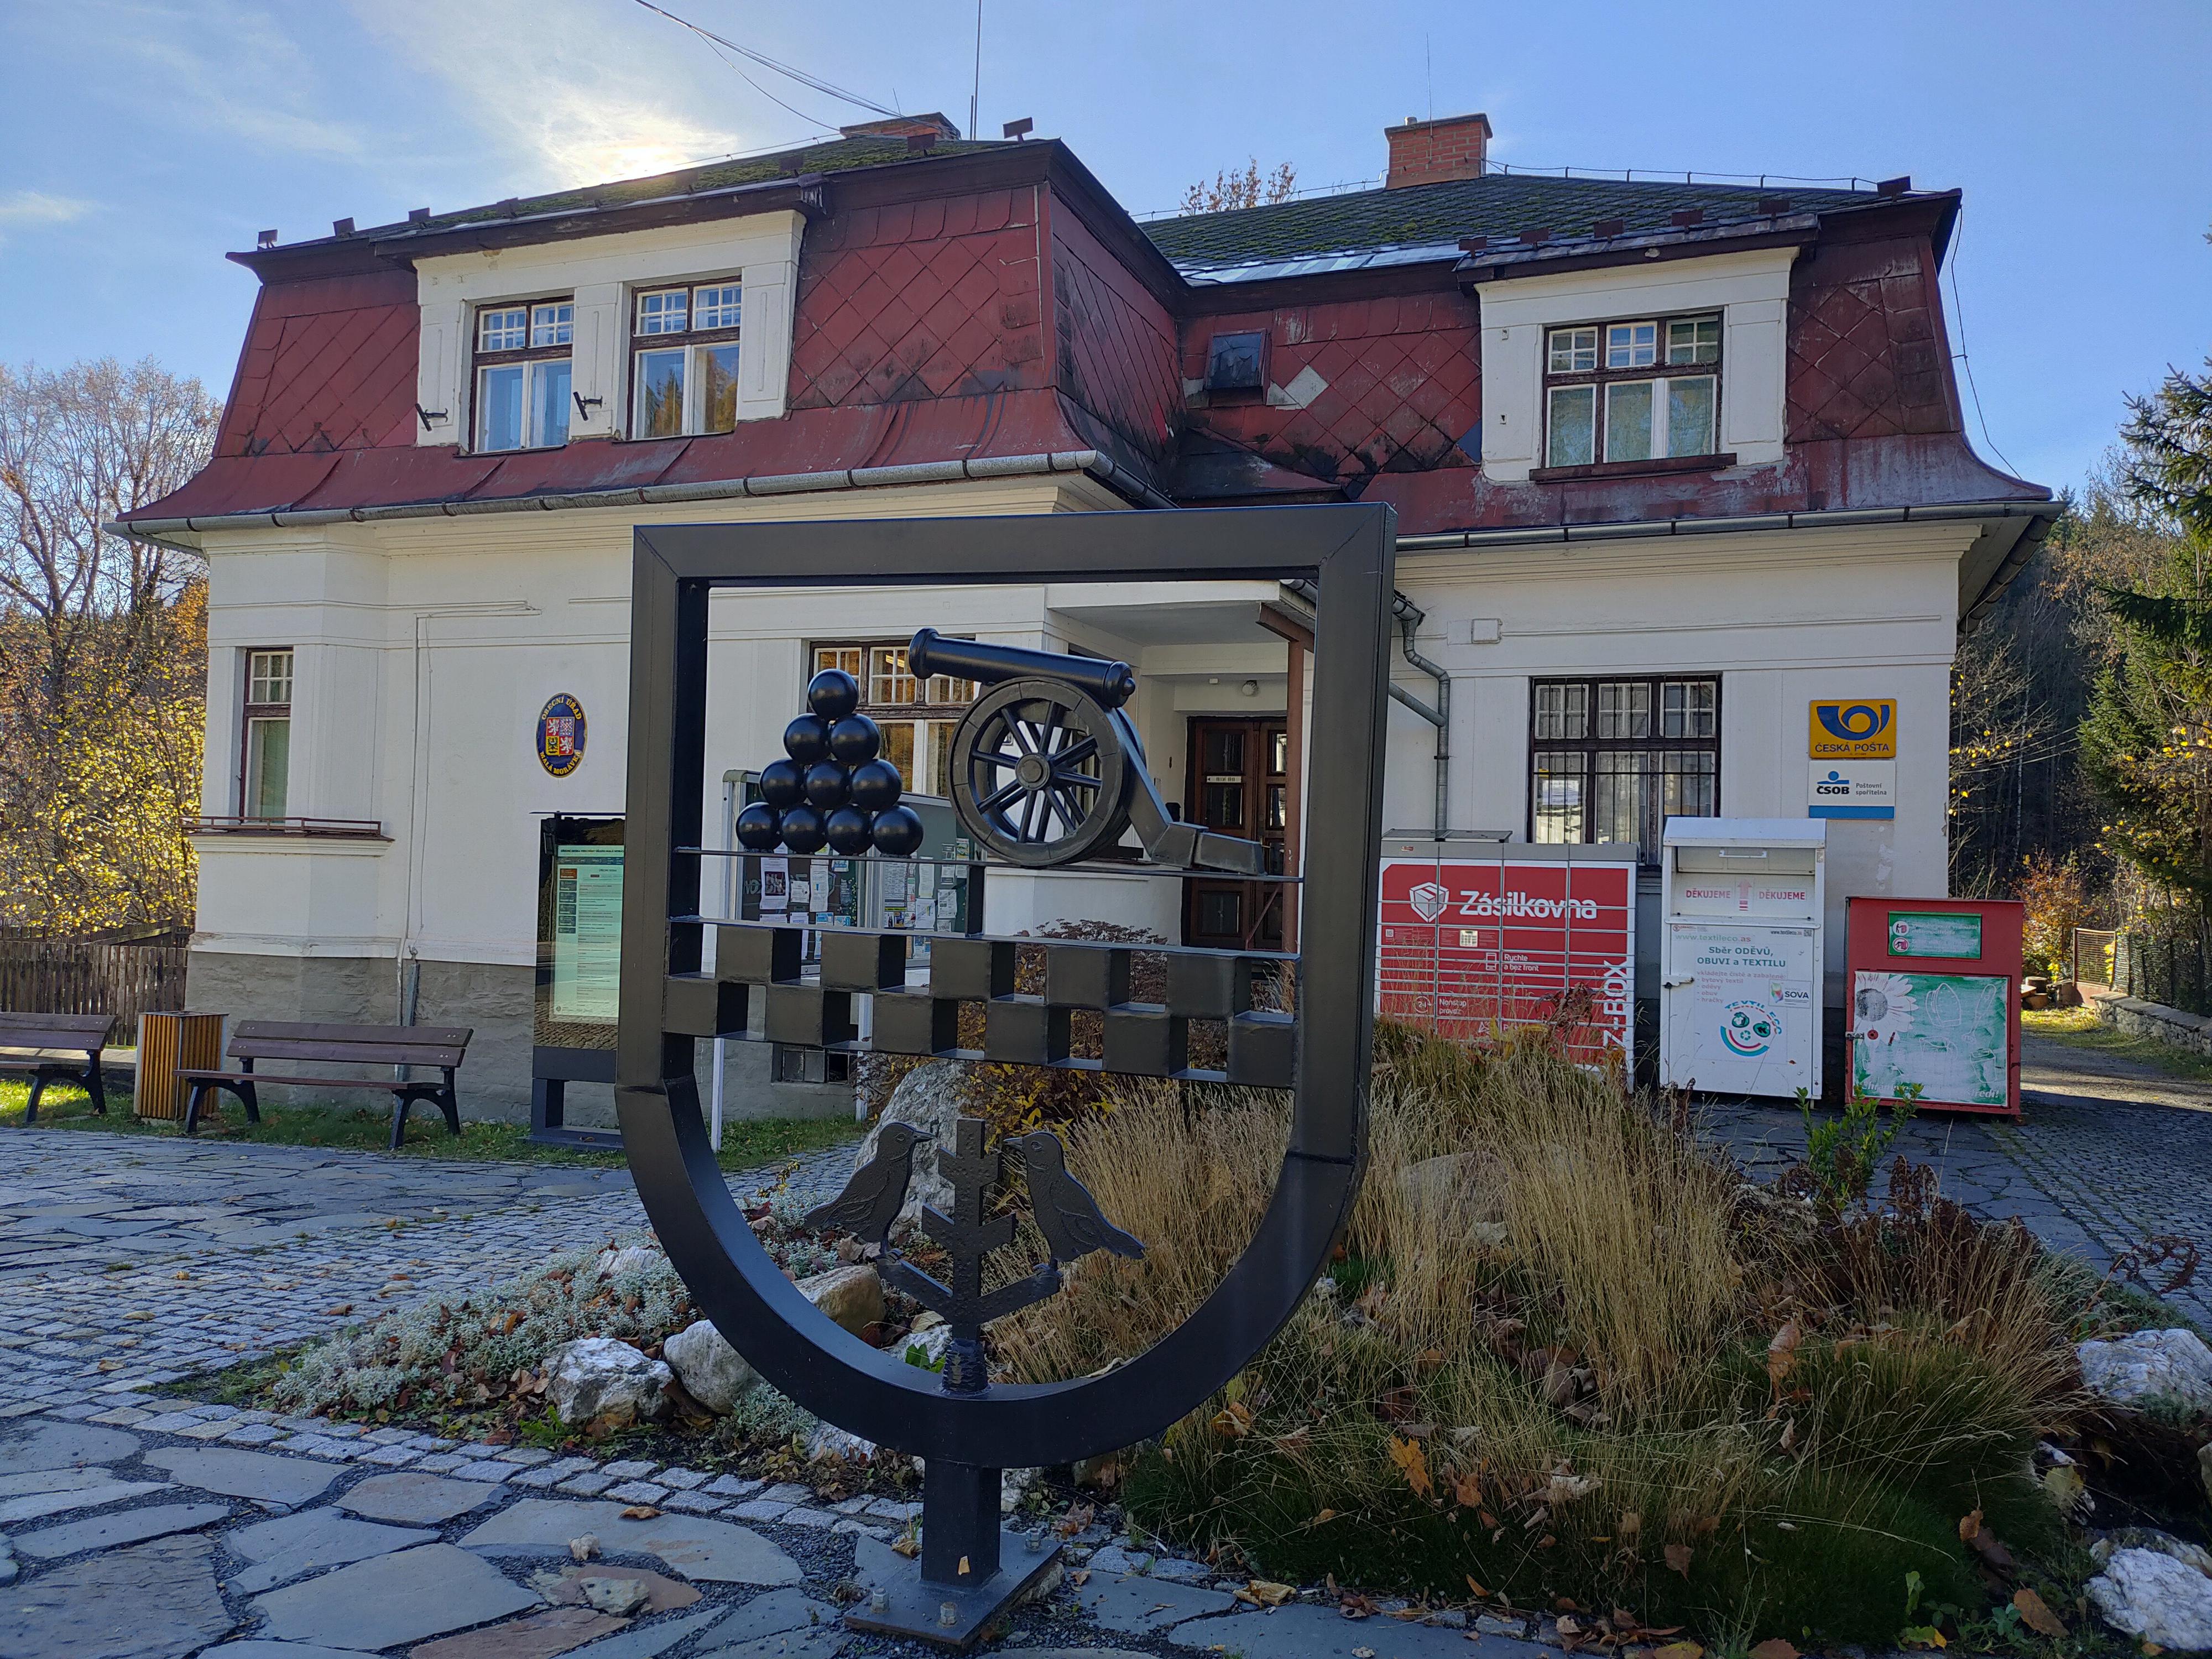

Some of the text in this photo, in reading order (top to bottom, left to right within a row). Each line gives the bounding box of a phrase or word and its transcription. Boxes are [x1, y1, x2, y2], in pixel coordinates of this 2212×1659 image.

[541, 695, 582, 720] OBECNÍ ÚŘAD
[1815, 742, 1890, 752] ČESKÁ POŠTA
[540, 751, 553, 772] MALÁ
[1817, 785, 1850, 795] ČSOB
[1686, 888, 1730, 899] DĚKUJEME
[1759, 889, 1806, 900] DĚKUJEME
[1459, 890, 1597, 919] Zásilkovna
[1674, 934, 1751, 942] www.textileco.as
[1709, 946, 1773, 957] Sběr ODĚVŮ,
[1697, 957, 1730, 966] OBUVI
[1742, 958, 1786, 967] TEXTILU
[1439, 998, 1467, 1008] Nonstop
[1604, 960, 1627, 1050] Z-BOX
